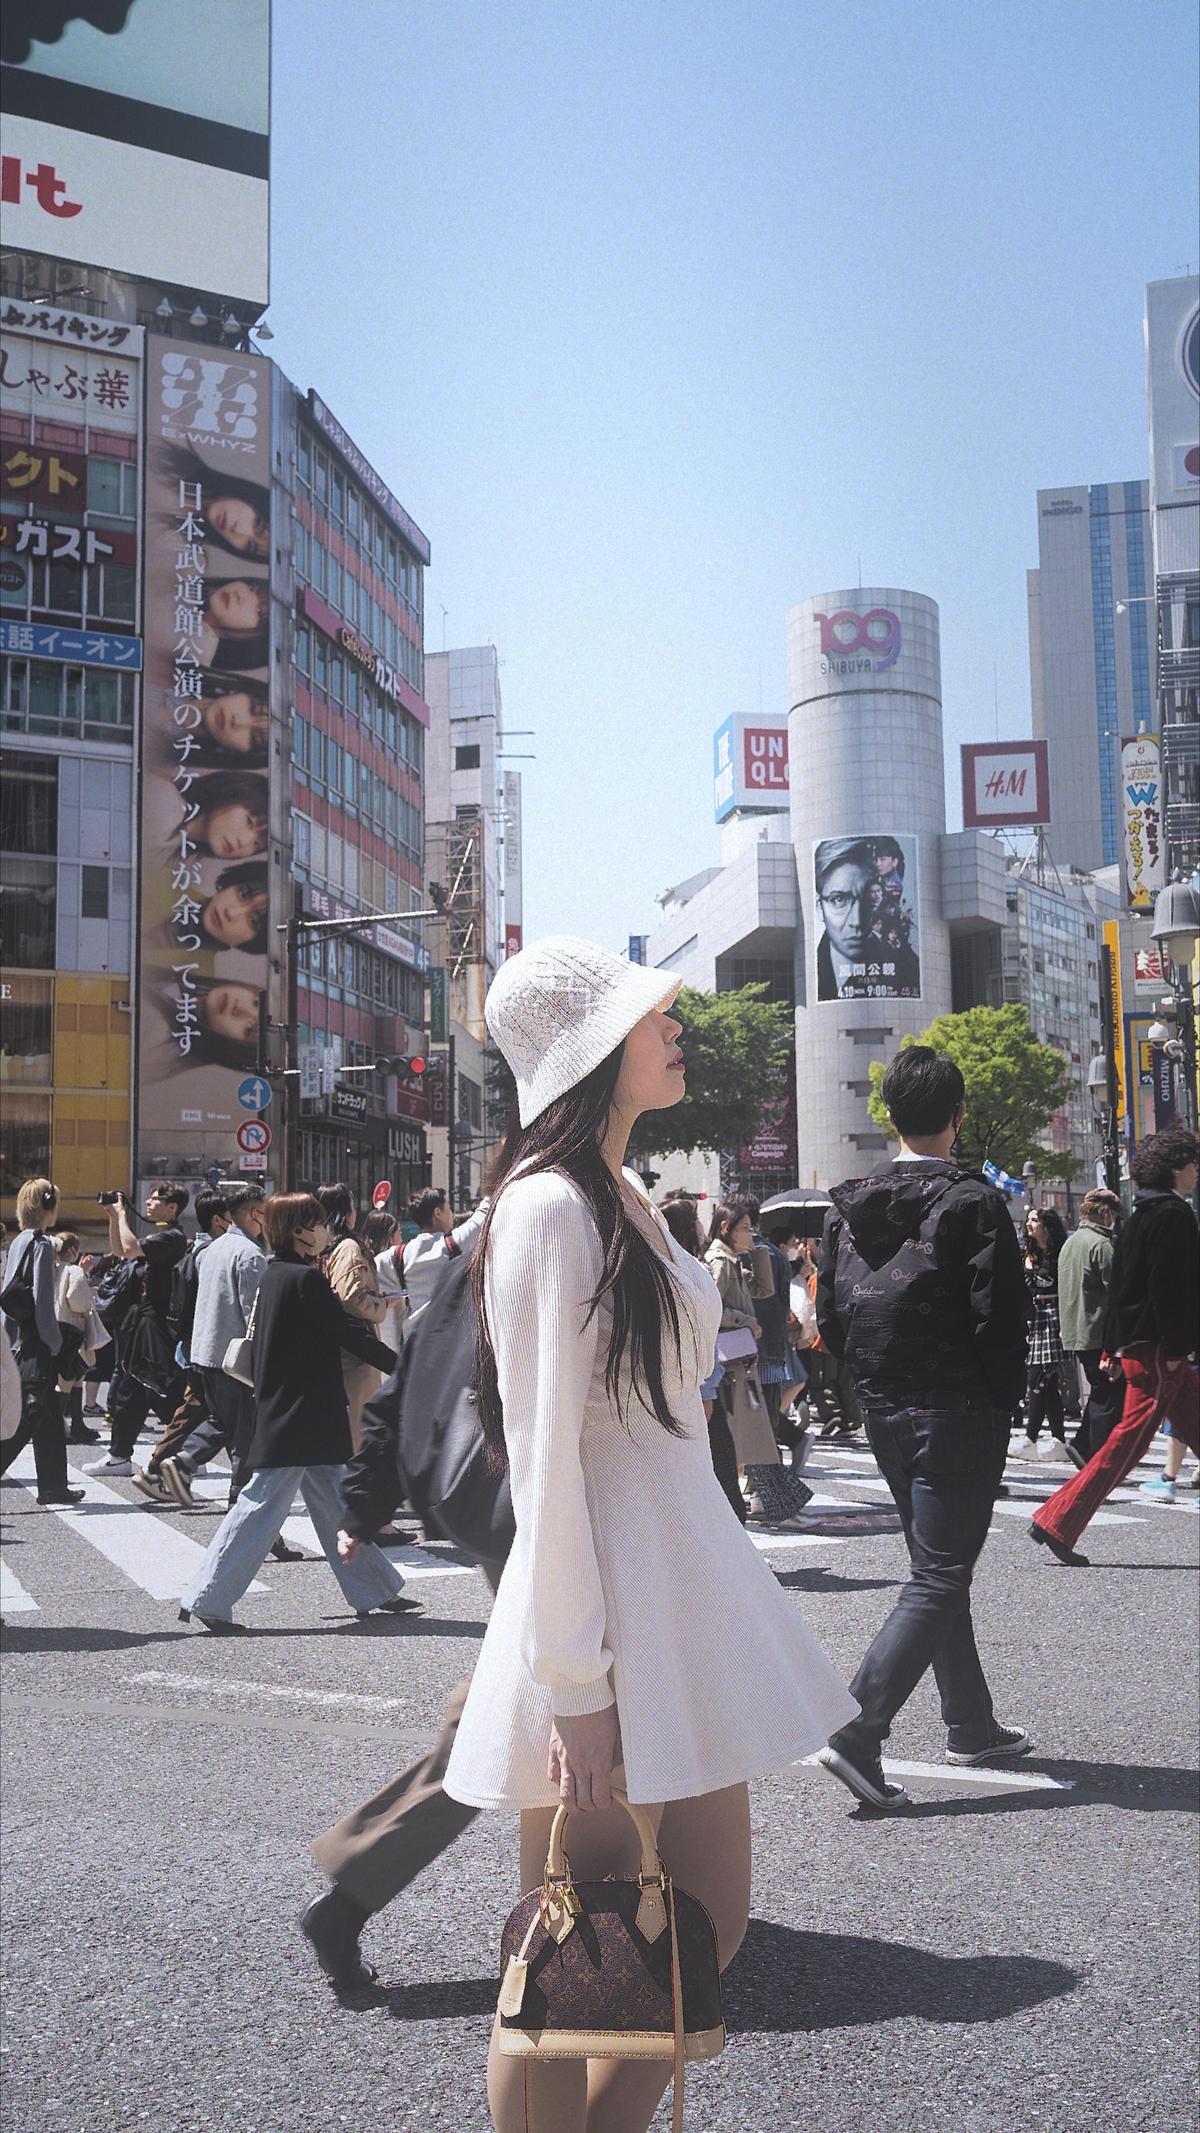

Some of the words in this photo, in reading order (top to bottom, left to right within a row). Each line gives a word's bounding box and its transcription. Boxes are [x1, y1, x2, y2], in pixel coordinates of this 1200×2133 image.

[0, 348, 129, 408] しゃぶ葉
[1042, 506, 1083, 517] INDIGO
[16, 520, 112, 563] ガスト
[813, 609, 902, 671] 109
[820, 660, 871, 675] SHIBUYA
[171, 480, 206, 1056] 日本武道館公演のチケットが余ってます
[984, 768, 1027, 798] H&M
[1160, 1059, 1171, 1102] MIZUHO
[388, 1128, 420, 1161] LUSH
